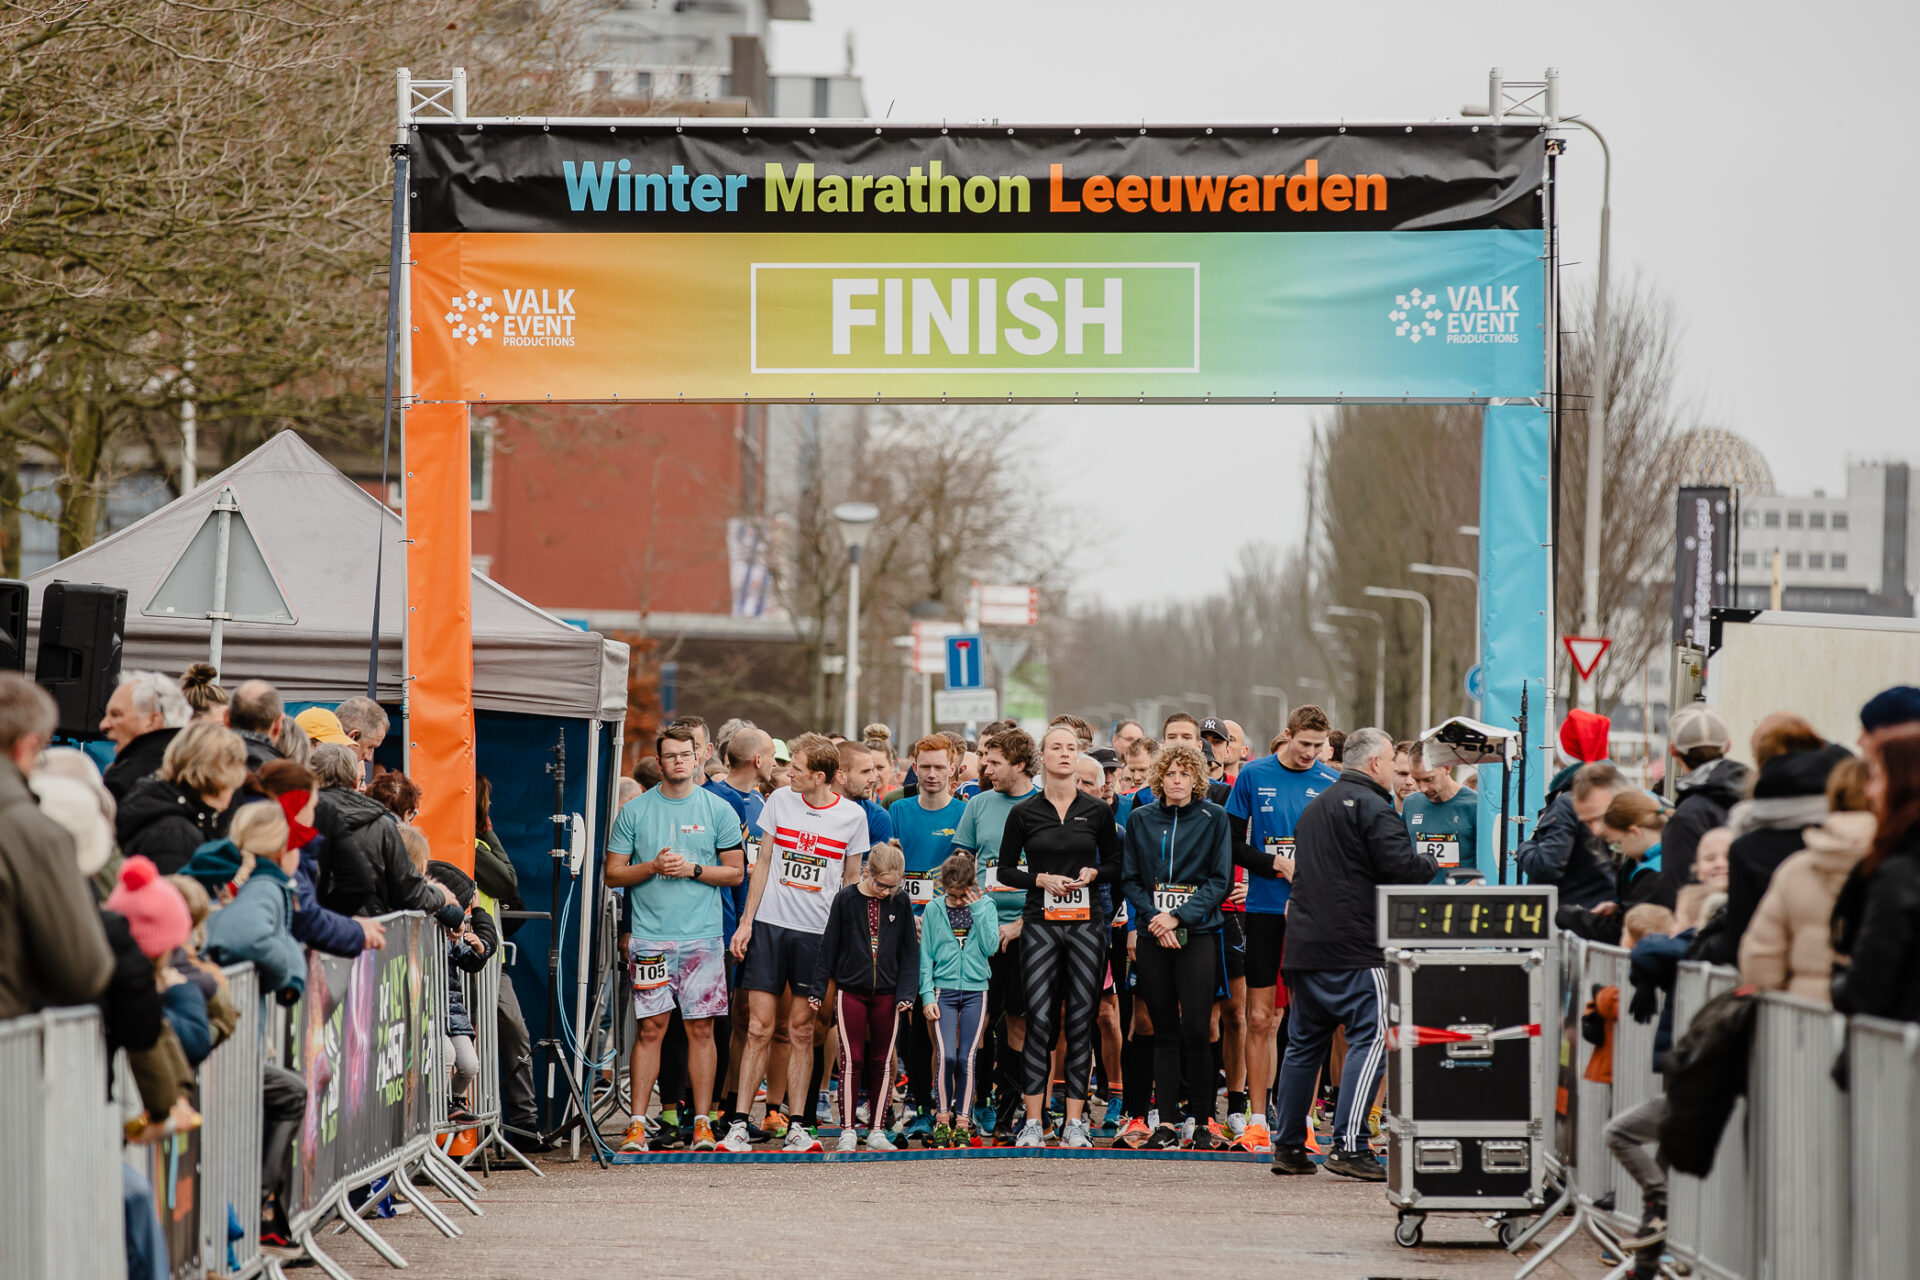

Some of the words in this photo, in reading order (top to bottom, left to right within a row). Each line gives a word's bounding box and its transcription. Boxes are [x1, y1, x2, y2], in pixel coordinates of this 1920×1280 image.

[562, 159, 747, 212] Winter
[765, 160, 1031, 213] Marathon
[1050, 159, 1387, 213] Leeuwarden
[502, 288, 576, 315] VALK
[1446, 285, 1520, 312] VALK
[503, 315, 576, 336] EVENT
[832, 277, 1123, 355] FINISH
[1447, 312, 1520, 334] EVENT
[503, 336, 576, 347] PRODUCTIONS
[1446, 333, 1519, 344] PRODUCTIONS
[1427, 843, 1445, 859] 62
[783, 861, 821, 883] 1031
[1157, 893, 1193, 909] 103
[638, 964, 666, 981] 105
